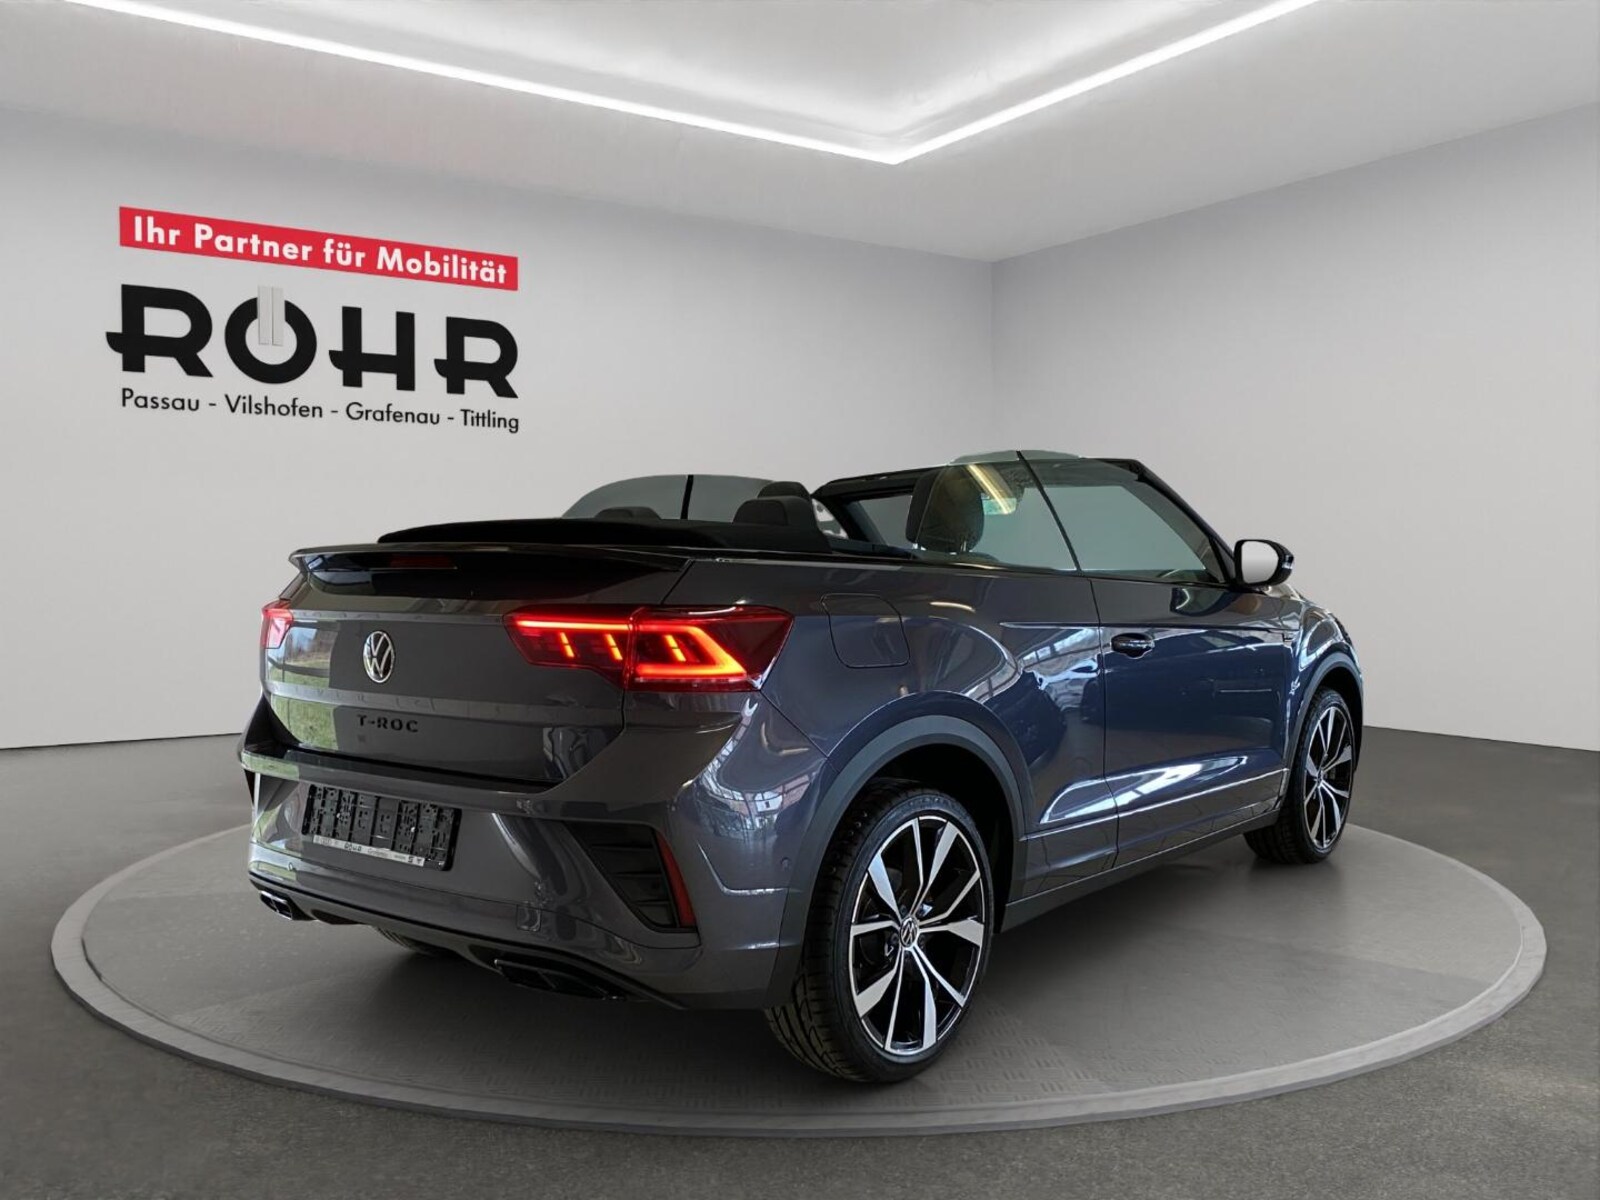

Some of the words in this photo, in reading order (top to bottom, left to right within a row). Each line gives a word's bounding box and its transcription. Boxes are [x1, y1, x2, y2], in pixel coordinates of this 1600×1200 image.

[133, 215, 181, 246] Ihr
[194, 223, 313, 261] Partner
[323, 238, 366, 268] für
[376, 246, 508, 284] Mobilität
[121, 387, 200, 412] Passau
[224, 394, 324, 419] Vilshofen
[345, 401, 441, 425] Grafenau
[460, 408, 520, 434] Tittling
[357, 714, 419, 734] T-ROC
